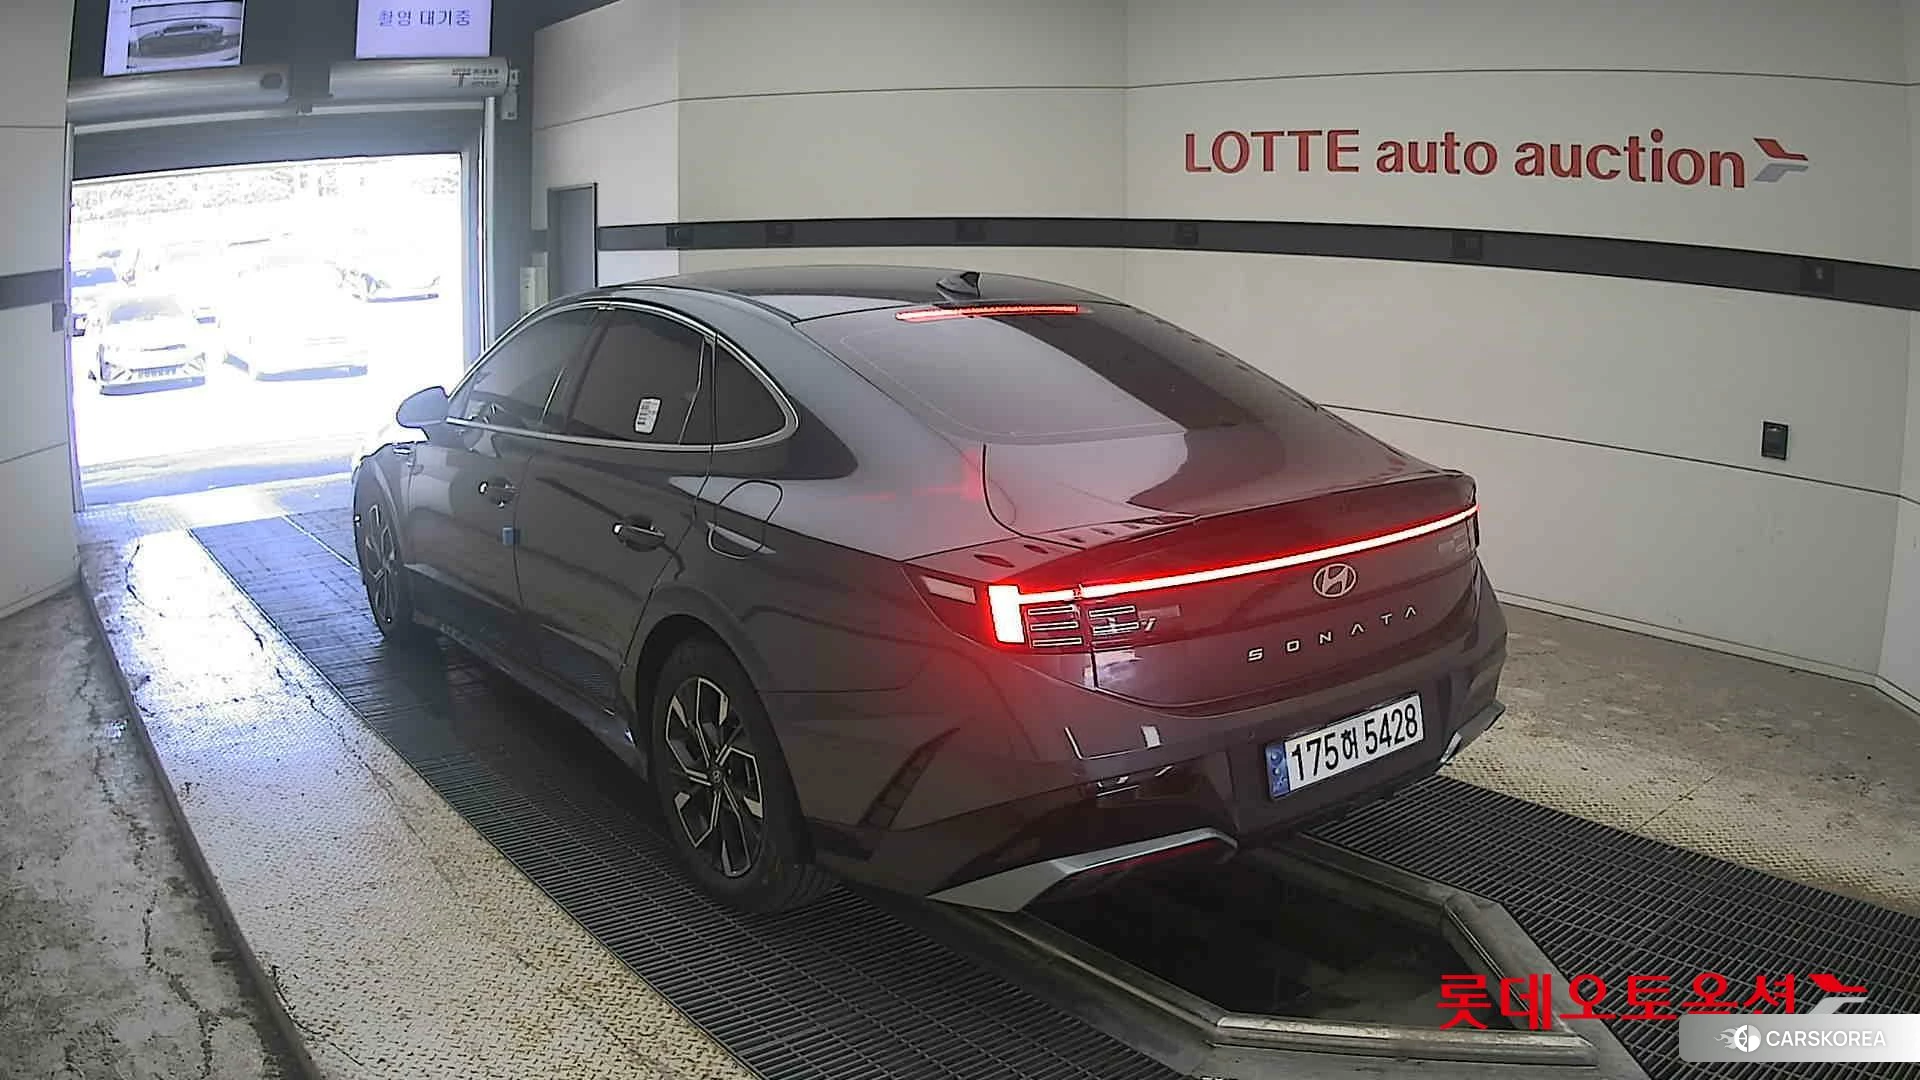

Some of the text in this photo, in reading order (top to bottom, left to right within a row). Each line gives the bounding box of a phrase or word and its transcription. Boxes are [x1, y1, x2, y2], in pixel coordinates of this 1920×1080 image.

[420, 9, 471, 26] 대기중
[1185, 129, 1746, 188] LOTTE auto auction
[1248, 606, 1416, 661] SONATA
[1291, 703, 1418, 781] 175허 5428
